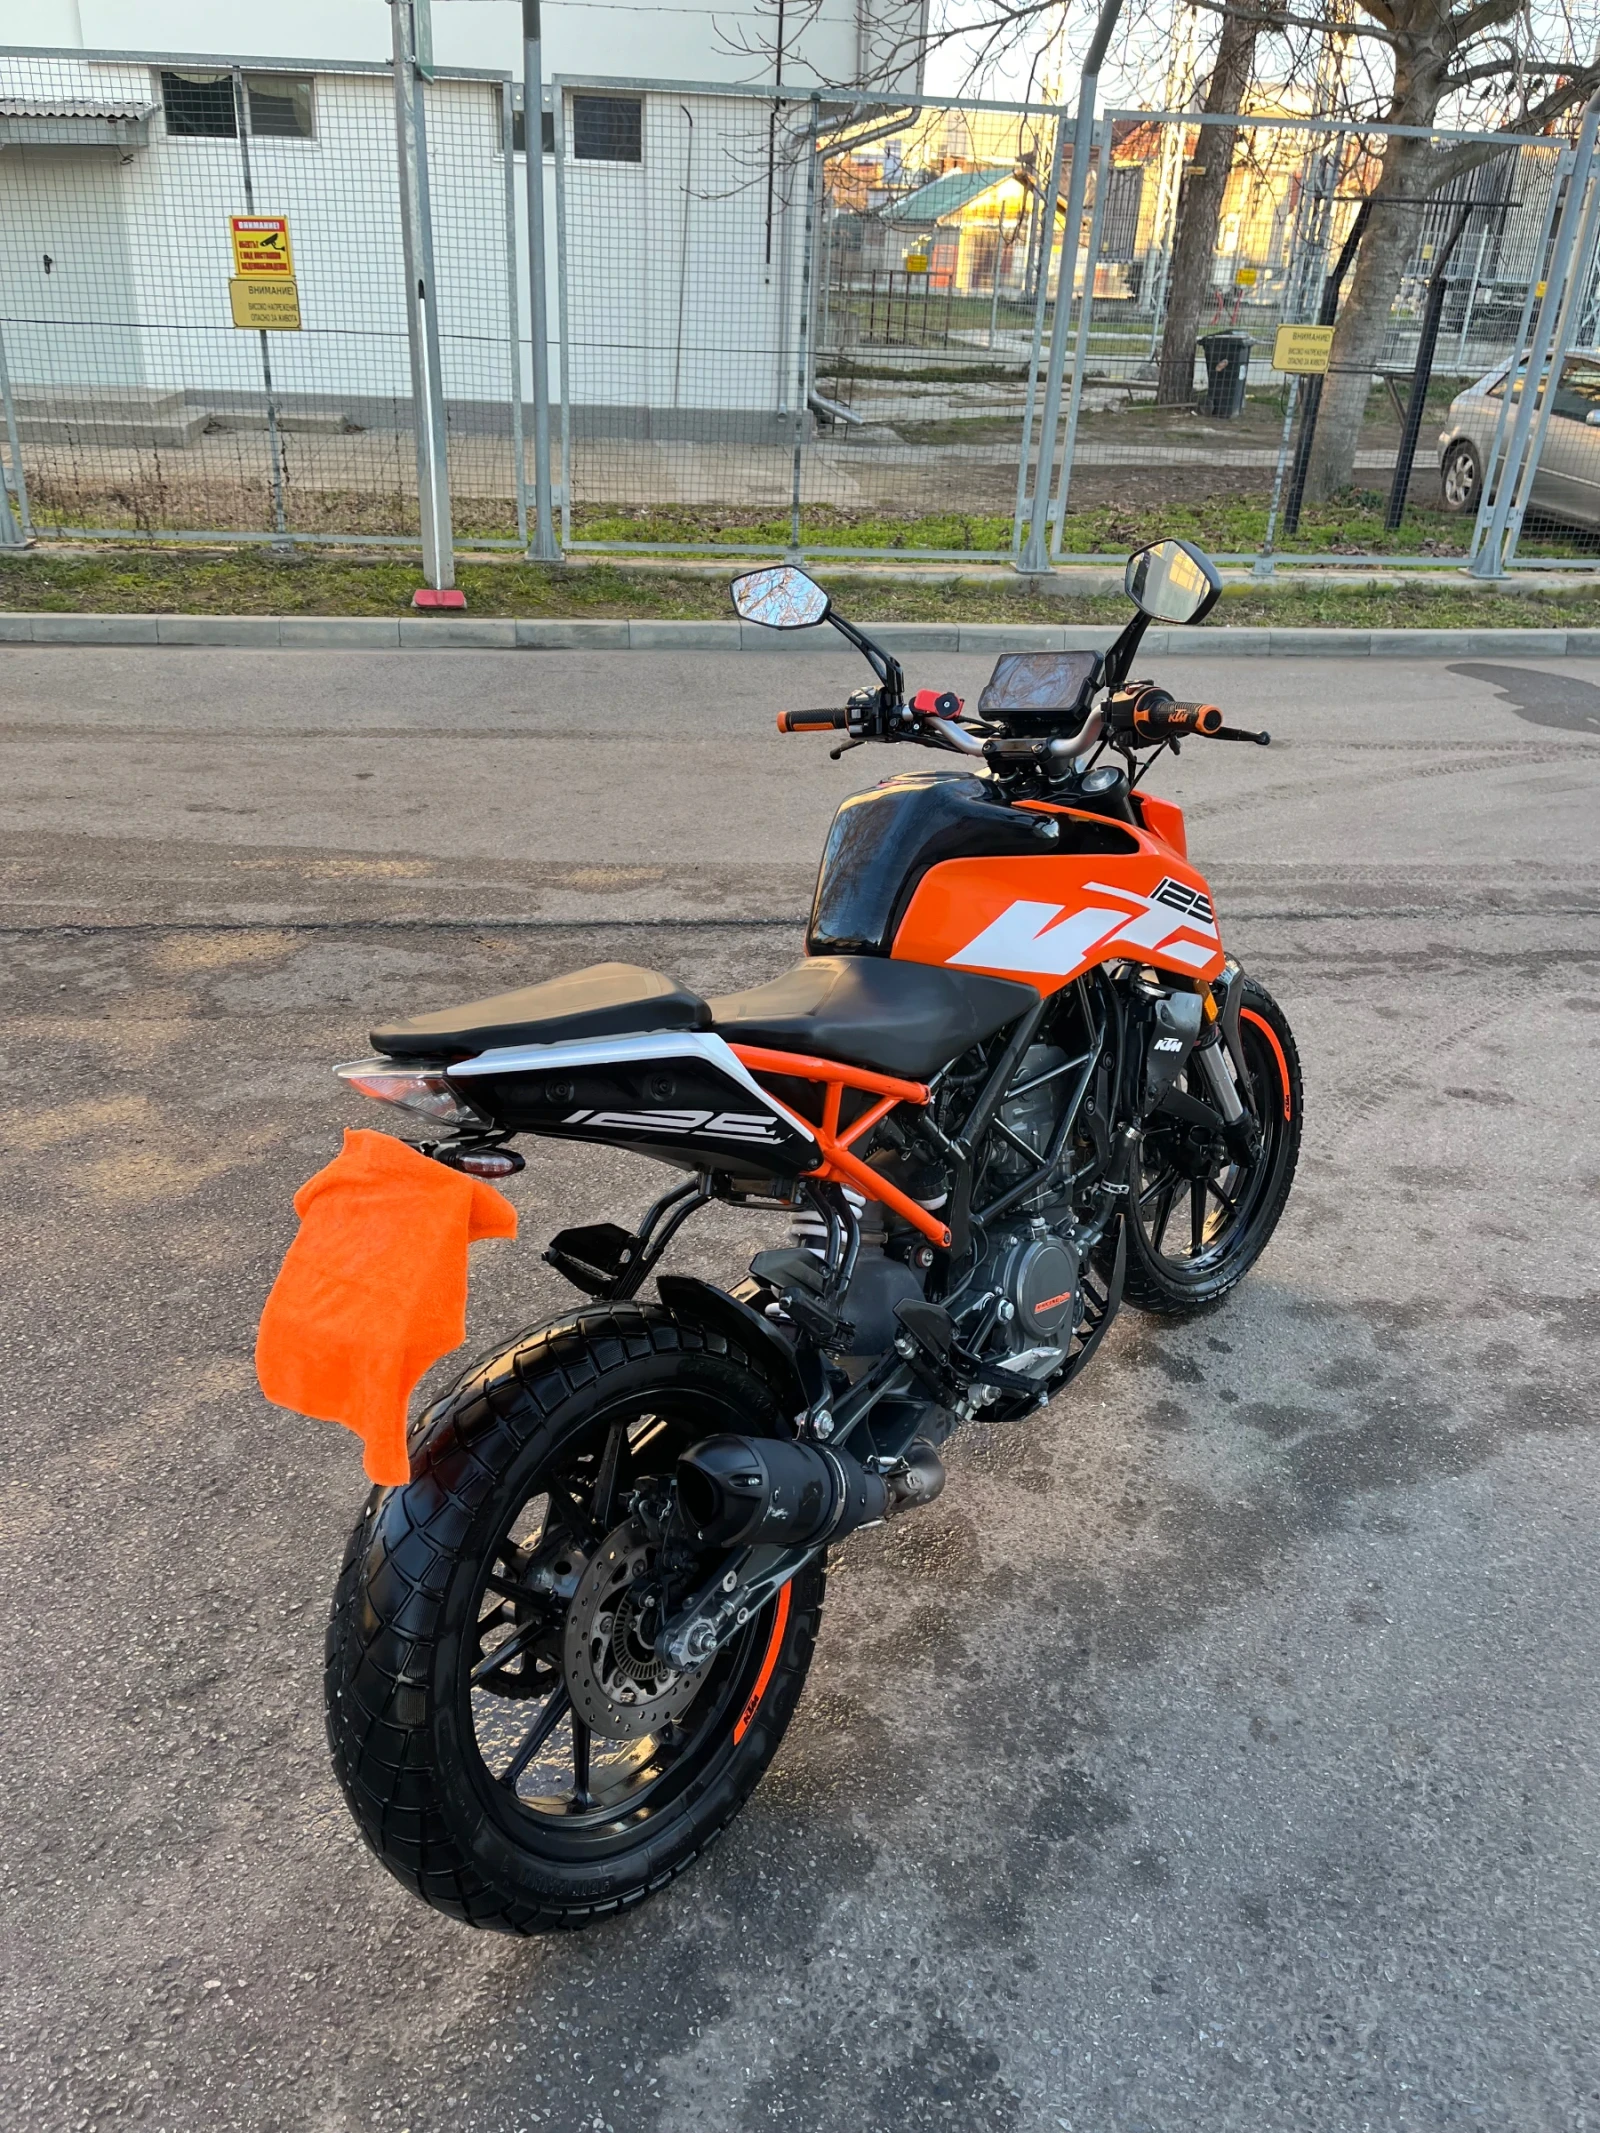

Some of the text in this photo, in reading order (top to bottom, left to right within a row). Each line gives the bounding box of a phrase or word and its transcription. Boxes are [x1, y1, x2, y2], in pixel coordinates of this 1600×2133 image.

[248, 286, 294, 296] ВНИМАНИЕ!
[1168, 709, 1188, 723] KTM
[1150, 878, 1214, 924] 125
[1153, 1037, 1183, 1052] KTM
[743, 1694, 760, 1726] KTM
